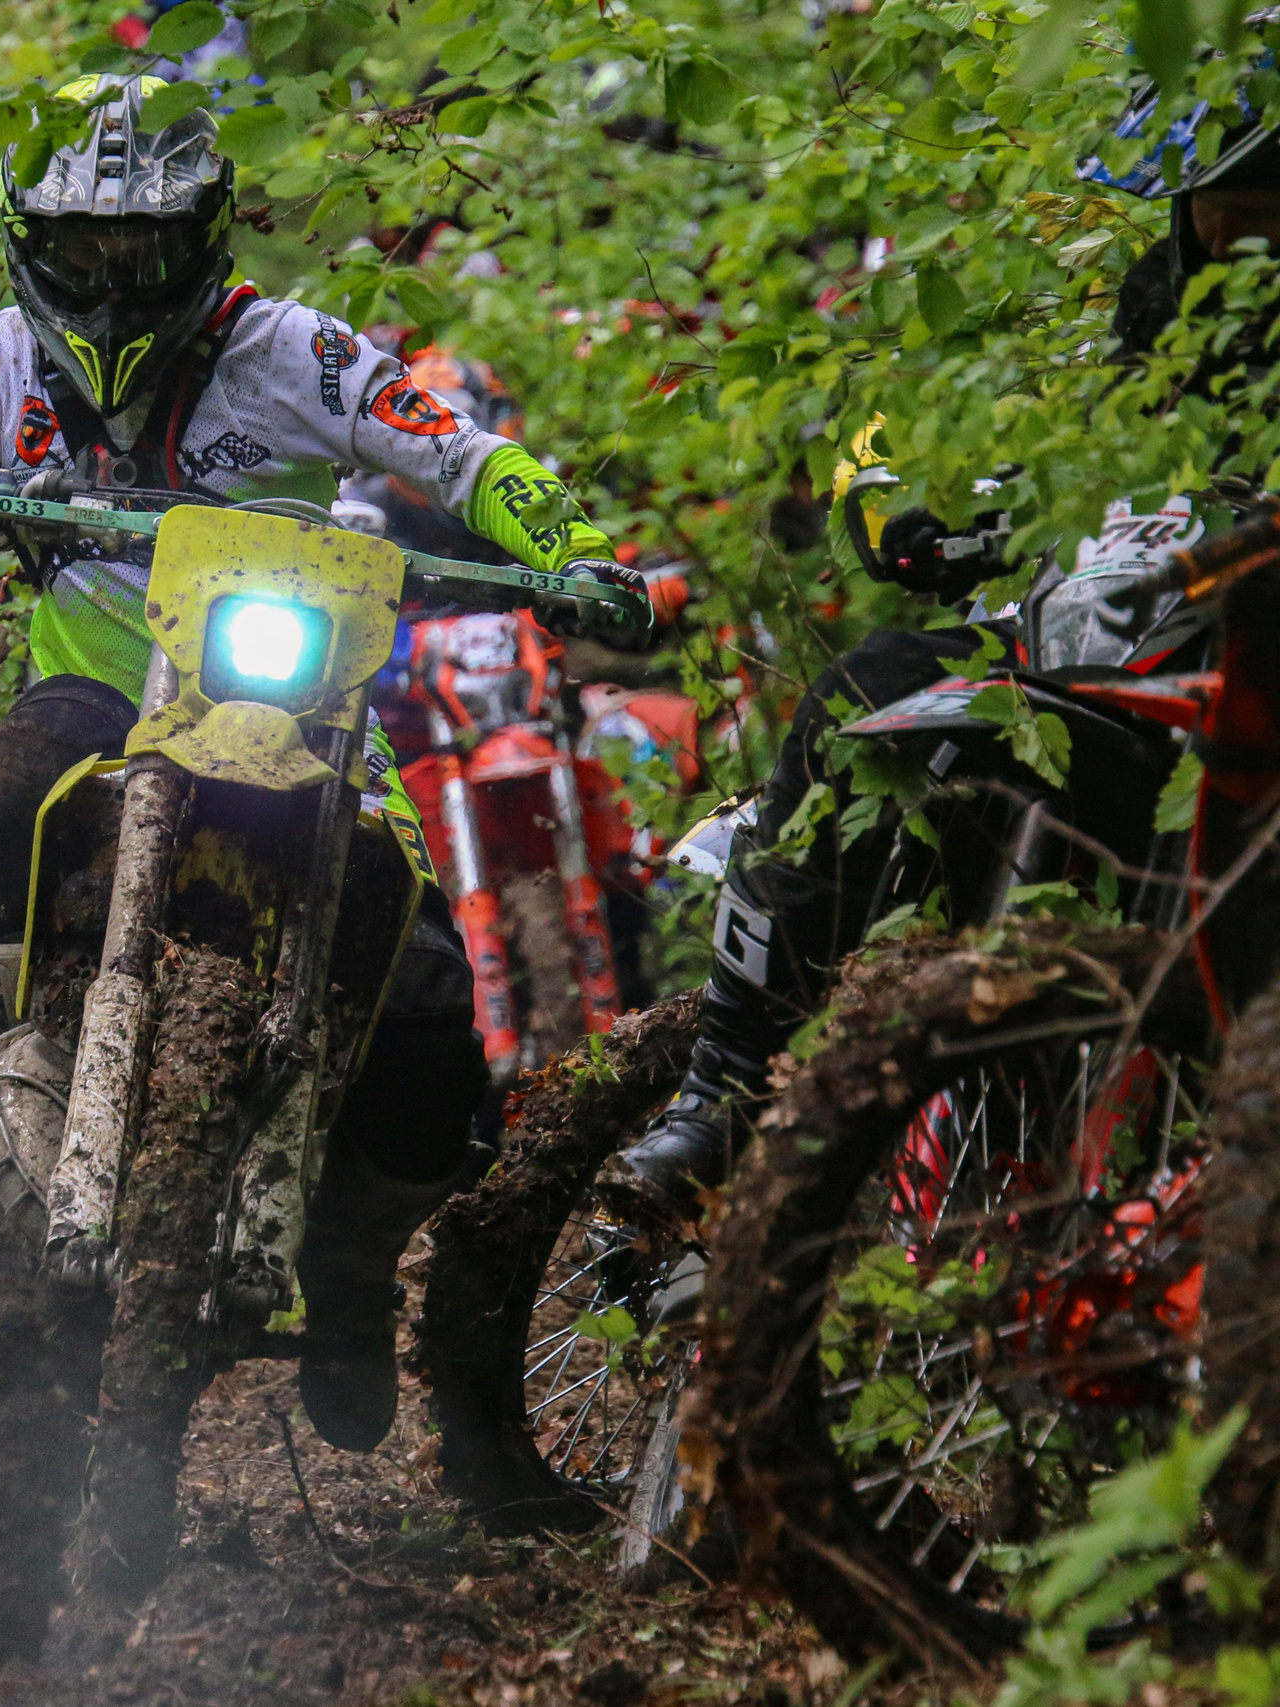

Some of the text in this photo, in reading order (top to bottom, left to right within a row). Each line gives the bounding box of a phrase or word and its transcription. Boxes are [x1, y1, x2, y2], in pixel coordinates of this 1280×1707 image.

[323, 347, 339, 396] START
[0, 498, 45, 516] 033
[520, 572, 566, 592] 033
